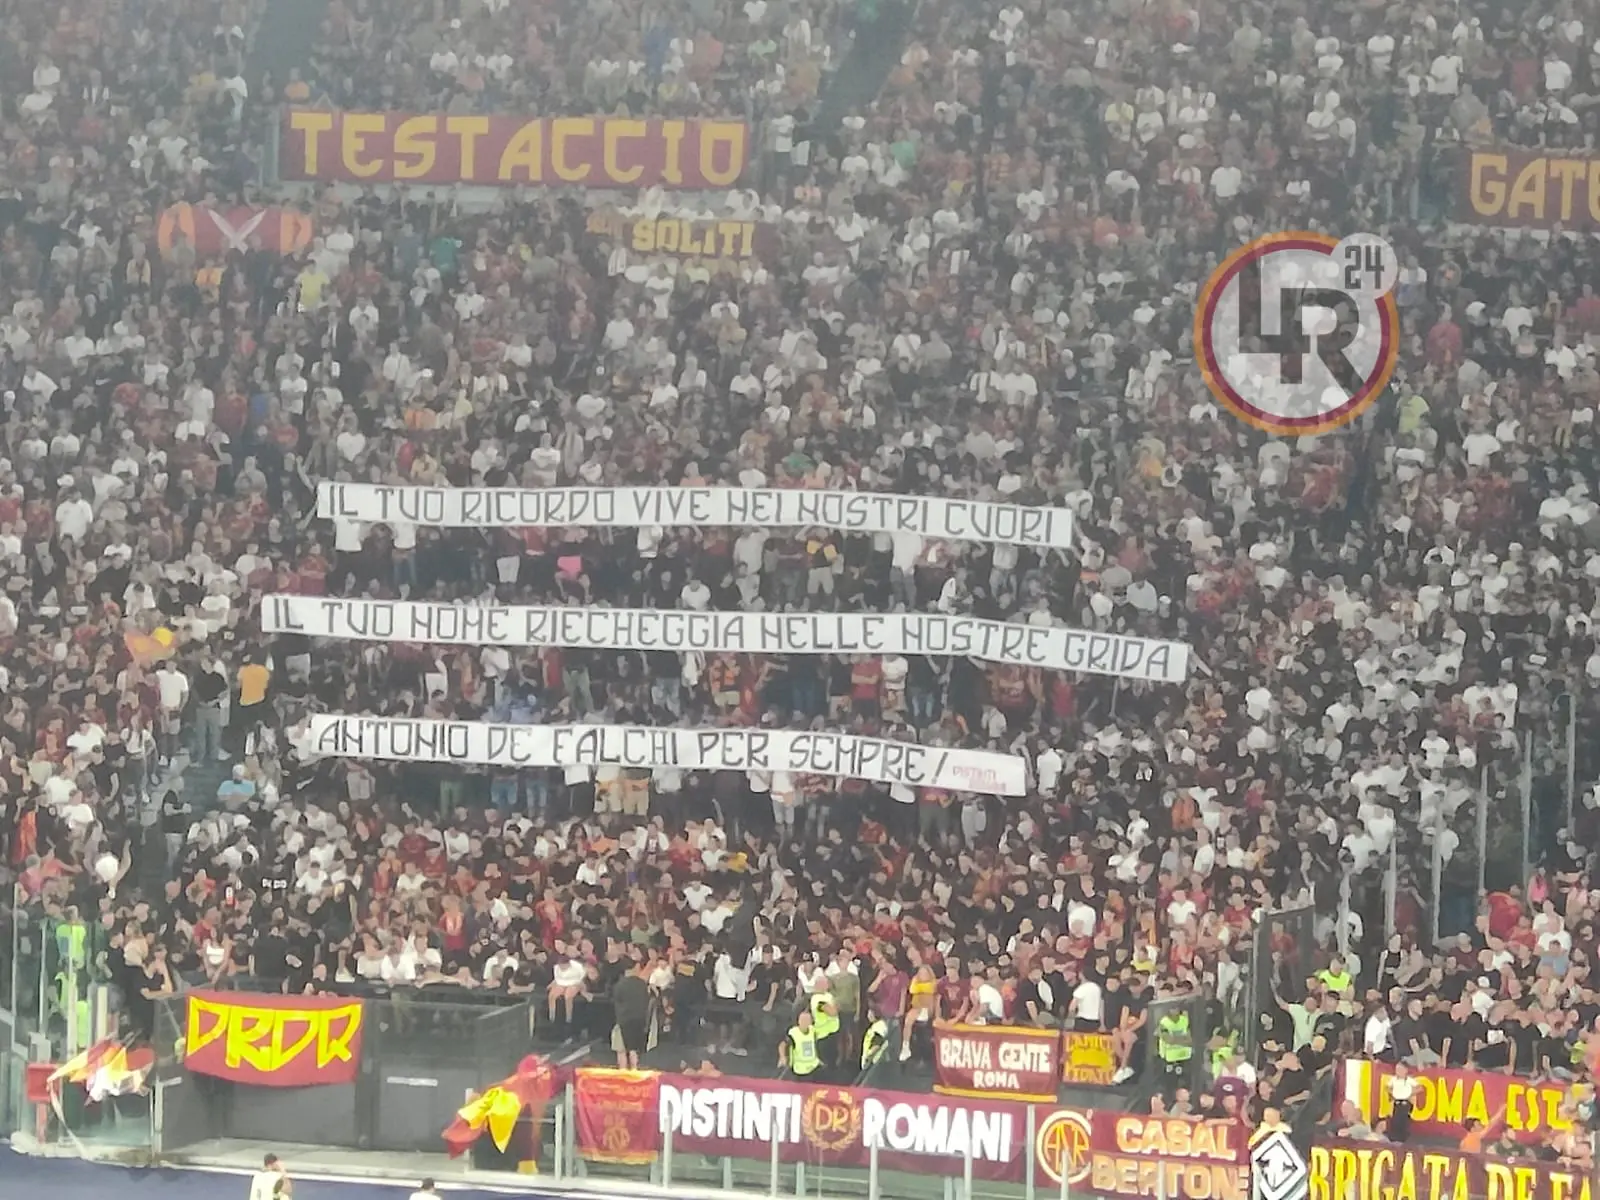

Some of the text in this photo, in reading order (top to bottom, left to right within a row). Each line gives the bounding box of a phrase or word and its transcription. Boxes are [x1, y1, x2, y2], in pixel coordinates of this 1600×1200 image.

[291, 111, 745, 185] TESTACCIO
[328, 485, 1053, 543] IL TUO RICORDO VIVE NEI NOSTRI CUORI
[273, 598, 1170, 678] IL TUO NOME RIECHEGGIA NELLE NOSTRE GRIDA
[318, 719, 469, 759] ANTONIO
[487, 726, 533, 762] DE
[553, 727, 678, 766] FALCHI
[697, 732, 770, 767] PER
[939, 1037, 993, 1070] BRAVA
[998, 1041, 1051, 1074] GENTE
[973, 1071, 1020, 1089] ROMA
[659, 1084, 802, 1143] DISTINTI
[863, 1098, 1012, 1163] ROMANI
[1116, 1117, 1236, 1161] CASAL
[1308, 1146, 1470, 1200] BRIGATA
